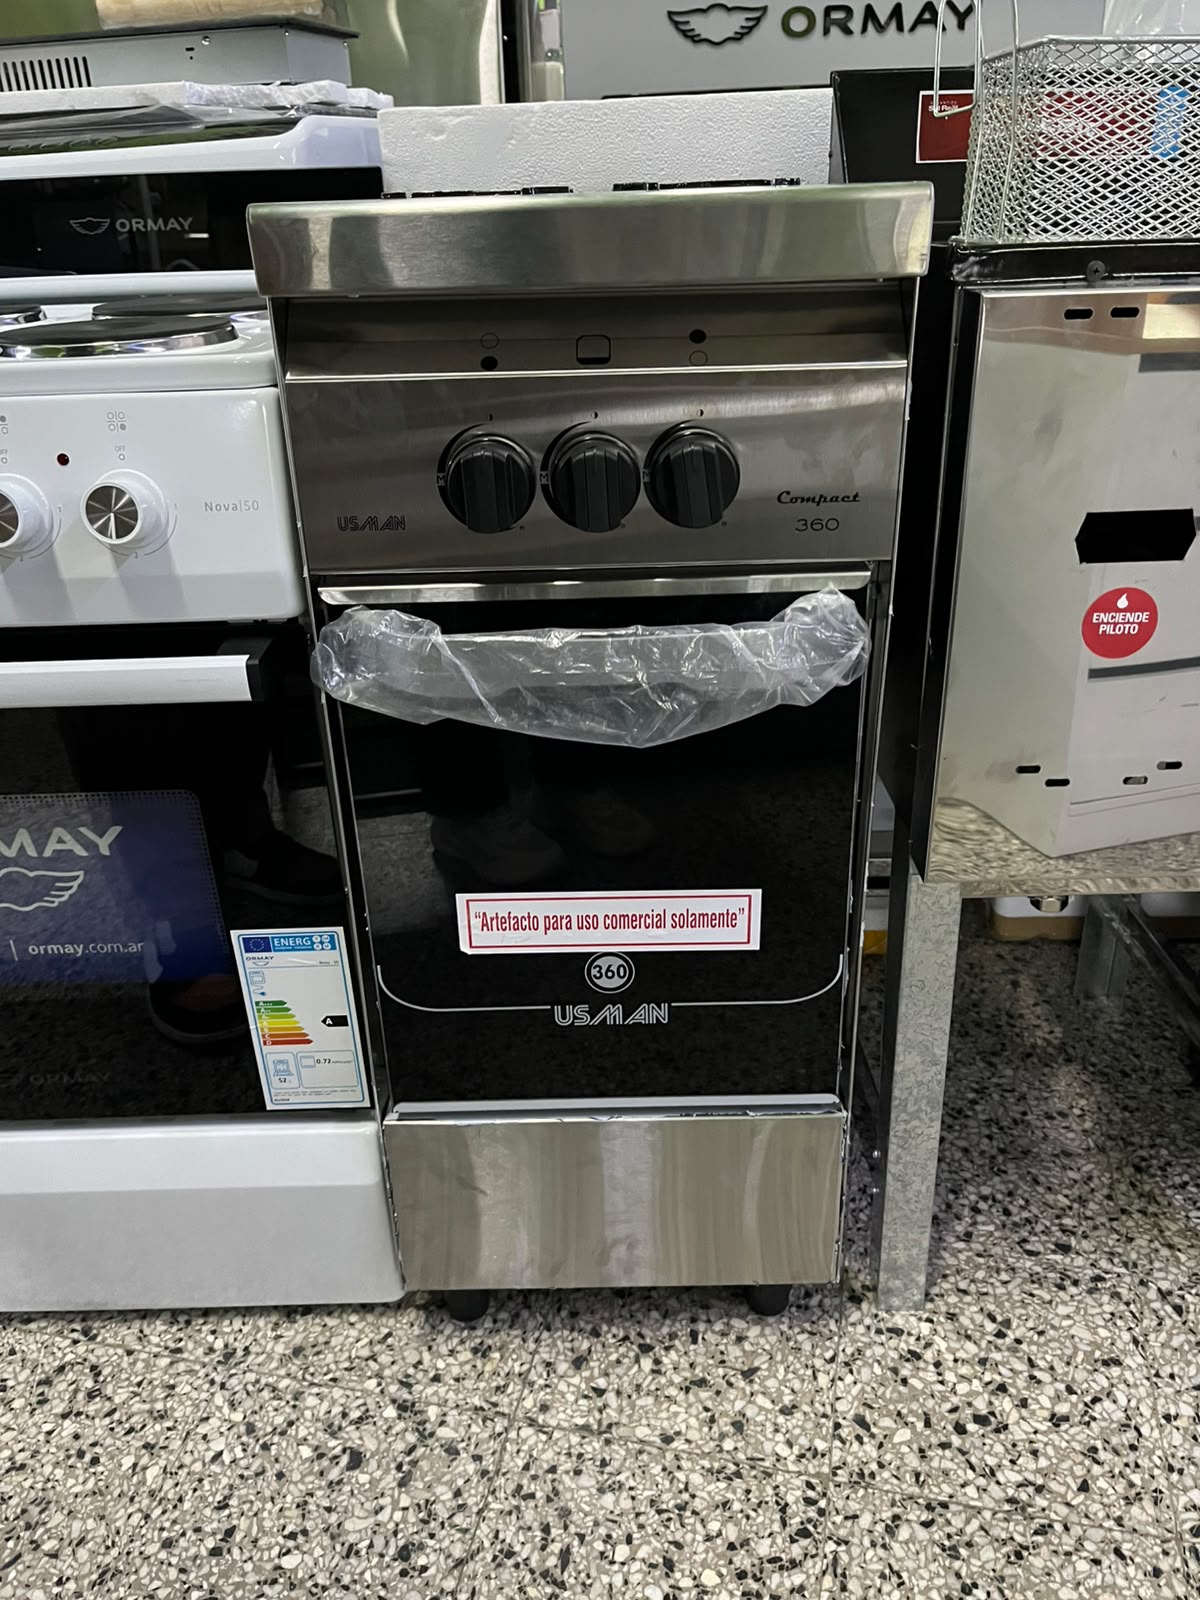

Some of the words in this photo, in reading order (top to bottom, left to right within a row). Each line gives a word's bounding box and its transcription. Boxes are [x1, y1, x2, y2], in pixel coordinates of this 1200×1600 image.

[780, 0, 974, 38] ORMAY
[115, 217, 193, 232] ORMAY
[776, 490, 861, 507] Compact
[336, 514, 406, 532] USMAN
[794, 517, 840, 532] 360
[1092, 611, 1150, 623] ENCIENDE
[1098, 623, 1139, 635] PILOTO
[543, 913, 573, 936] para
[576, 913, 600, 931] uso
[602, 908, 667, 930] comercial
[273, 937, 312, 946] ENERG
[28, 942, 144, 957] ormay.com.ar
[592, 964, 628, 980] 360
[325, 1017, 333, 1026] A
[553, 1002, 669, 1026] USMAN
